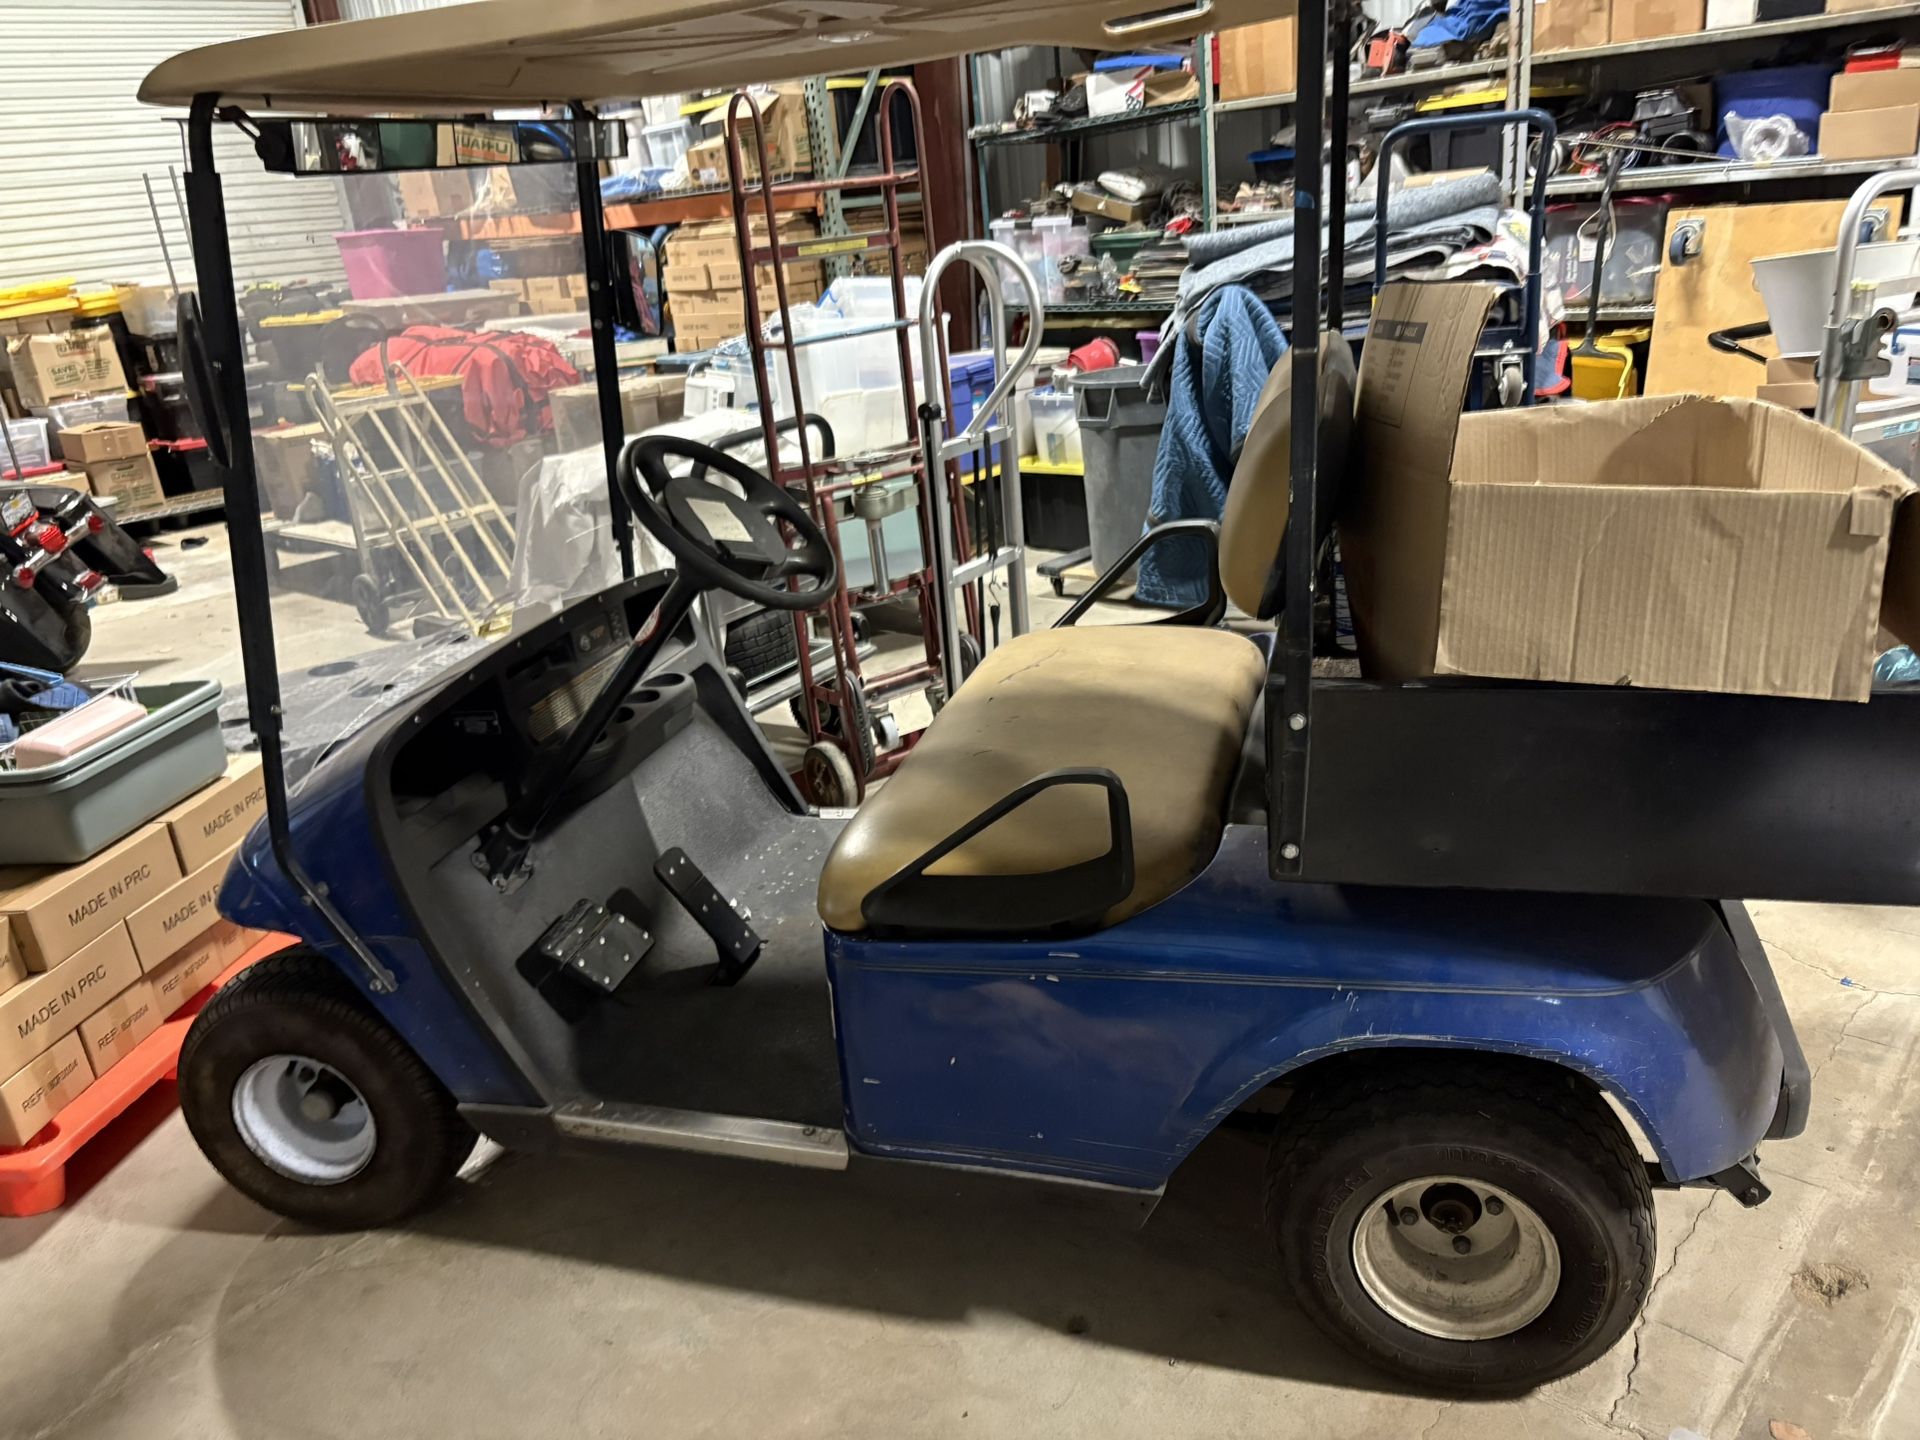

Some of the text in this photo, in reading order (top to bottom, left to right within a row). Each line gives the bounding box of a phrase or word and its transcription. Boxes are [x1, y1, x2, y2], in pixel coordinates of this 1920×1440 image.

[203, 787, 265, 838] MADE IN PRC
[68, 864, 151, 927] MADE IN PRC
[162, 900, 198, 933] MADE
[199, 890, 211, 906] IN
[17, 964, 107, 1039] MADE IN PRC
